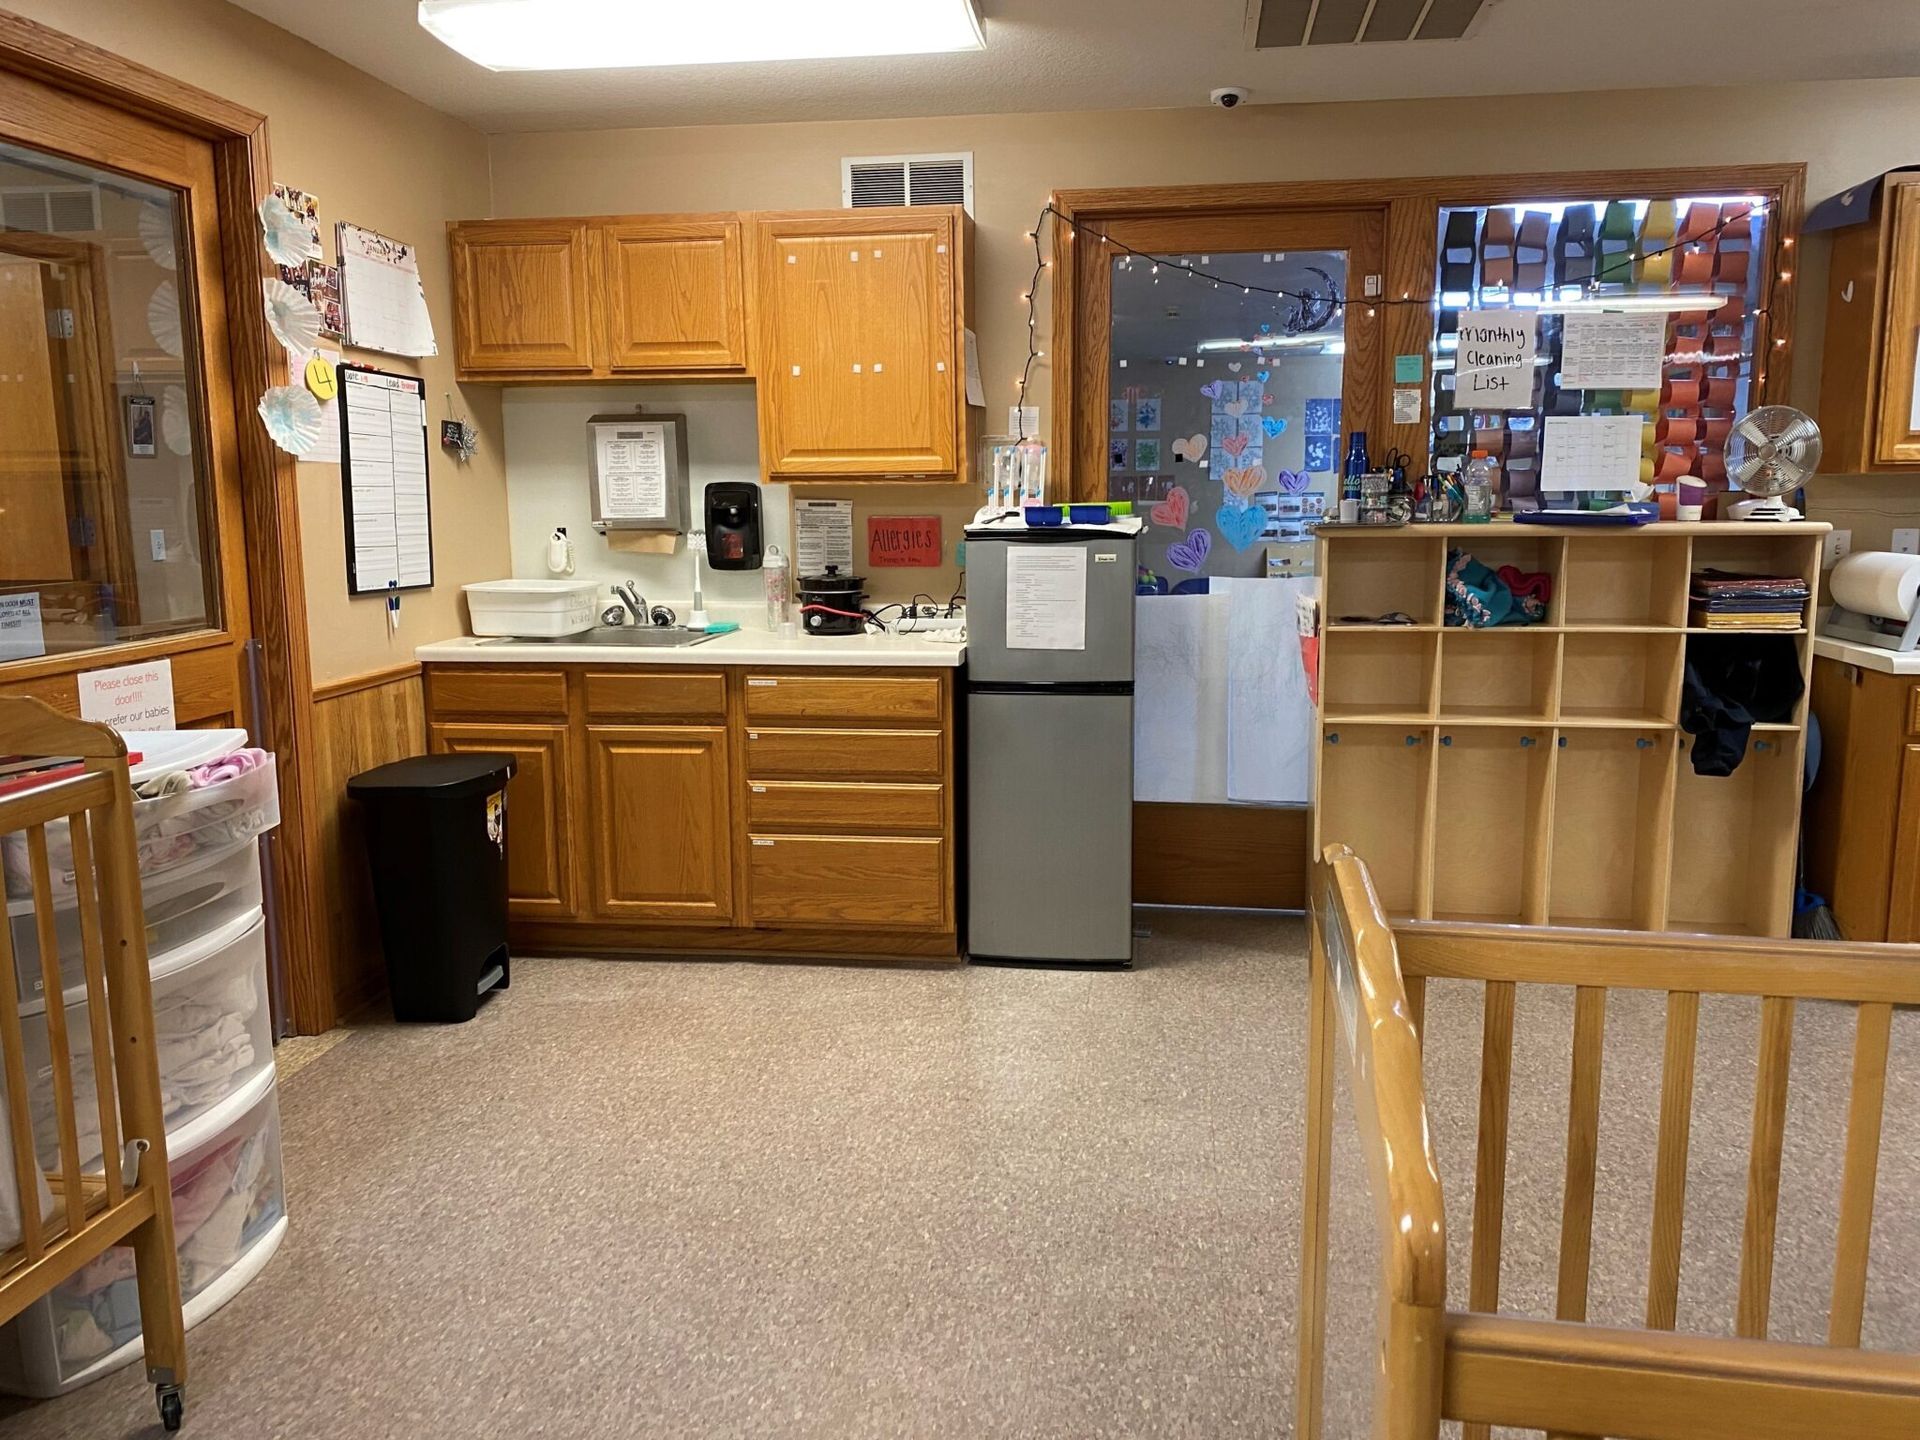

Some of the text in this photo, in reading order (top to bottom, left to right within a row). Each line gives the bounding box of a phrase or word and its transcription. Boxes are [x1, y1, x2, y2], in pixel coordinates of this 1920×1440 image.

[1459, 326, 1526, 349] Monthly
[1466, 350, 1523, 369] Cleaning
[313, 364, 333, 392] 4
[1473, 373, 1510, 391] List
[870, 528, 932, 553] Allergies
[94, 671, 159, 692] Please close this
[104, 705, 170, 726] prefer our babies
